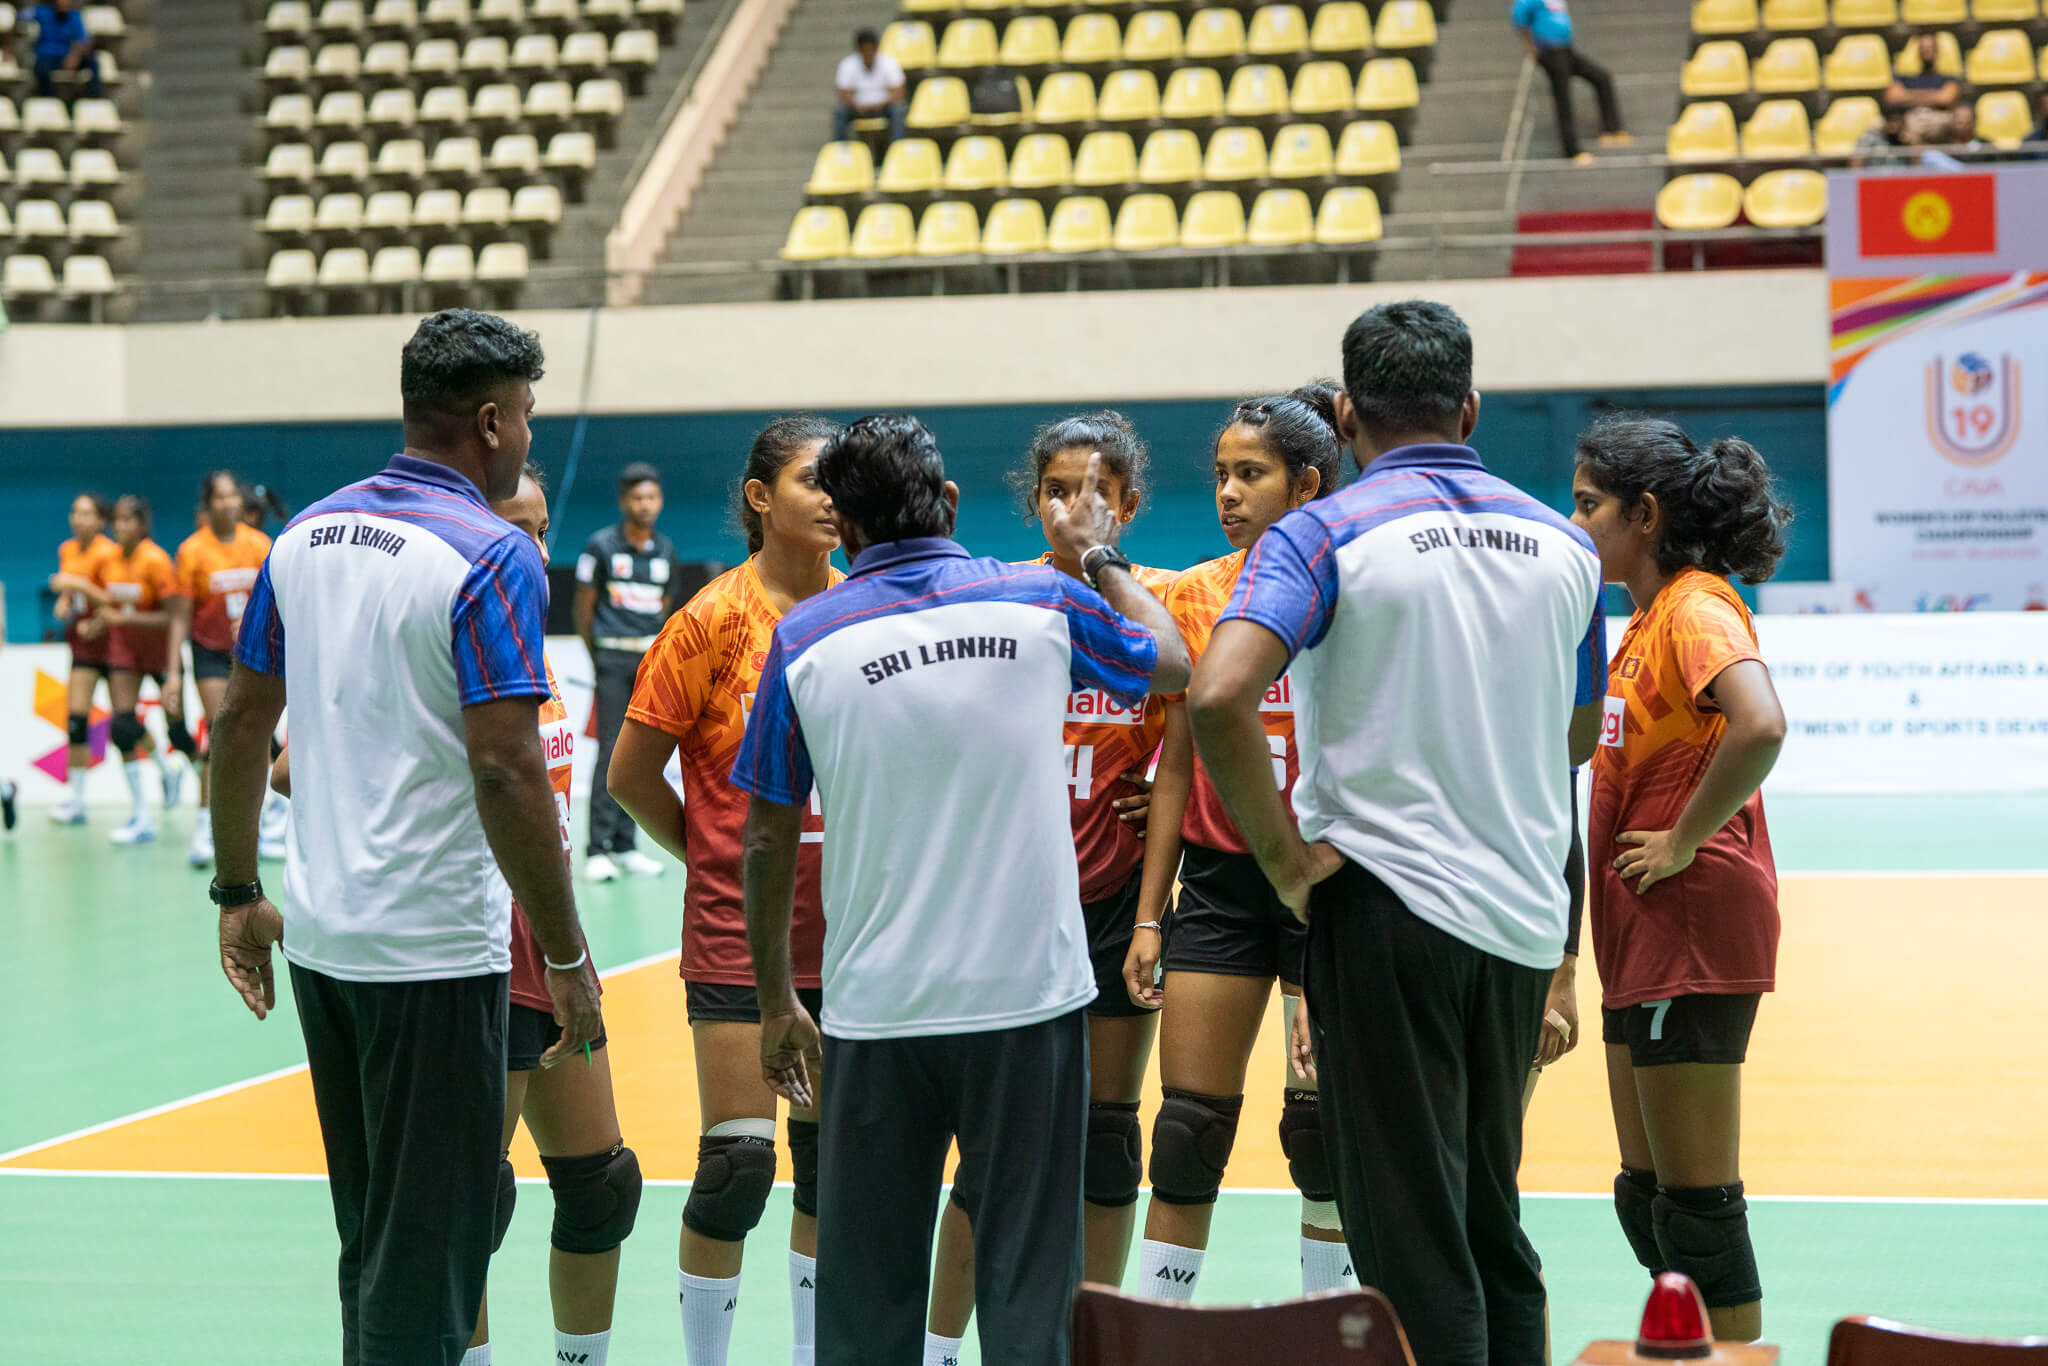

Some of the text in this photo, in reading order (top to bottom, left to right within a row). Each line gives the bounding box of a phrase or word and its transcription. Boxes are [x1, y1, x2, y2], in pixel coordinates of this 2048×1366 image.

[1951, 405, 1996, 439] 19
[310, 525, 407, 557] SRI LANKA
[1408, 527, 1539, 558] SRI LANKA
[860, 636, 1017, 686] SRI LANKA
[1867, 718, 1894, 736] OF
[1904, 717, 1988, 736] SPORTS
[1641, 999, 1672, 1040] 7
